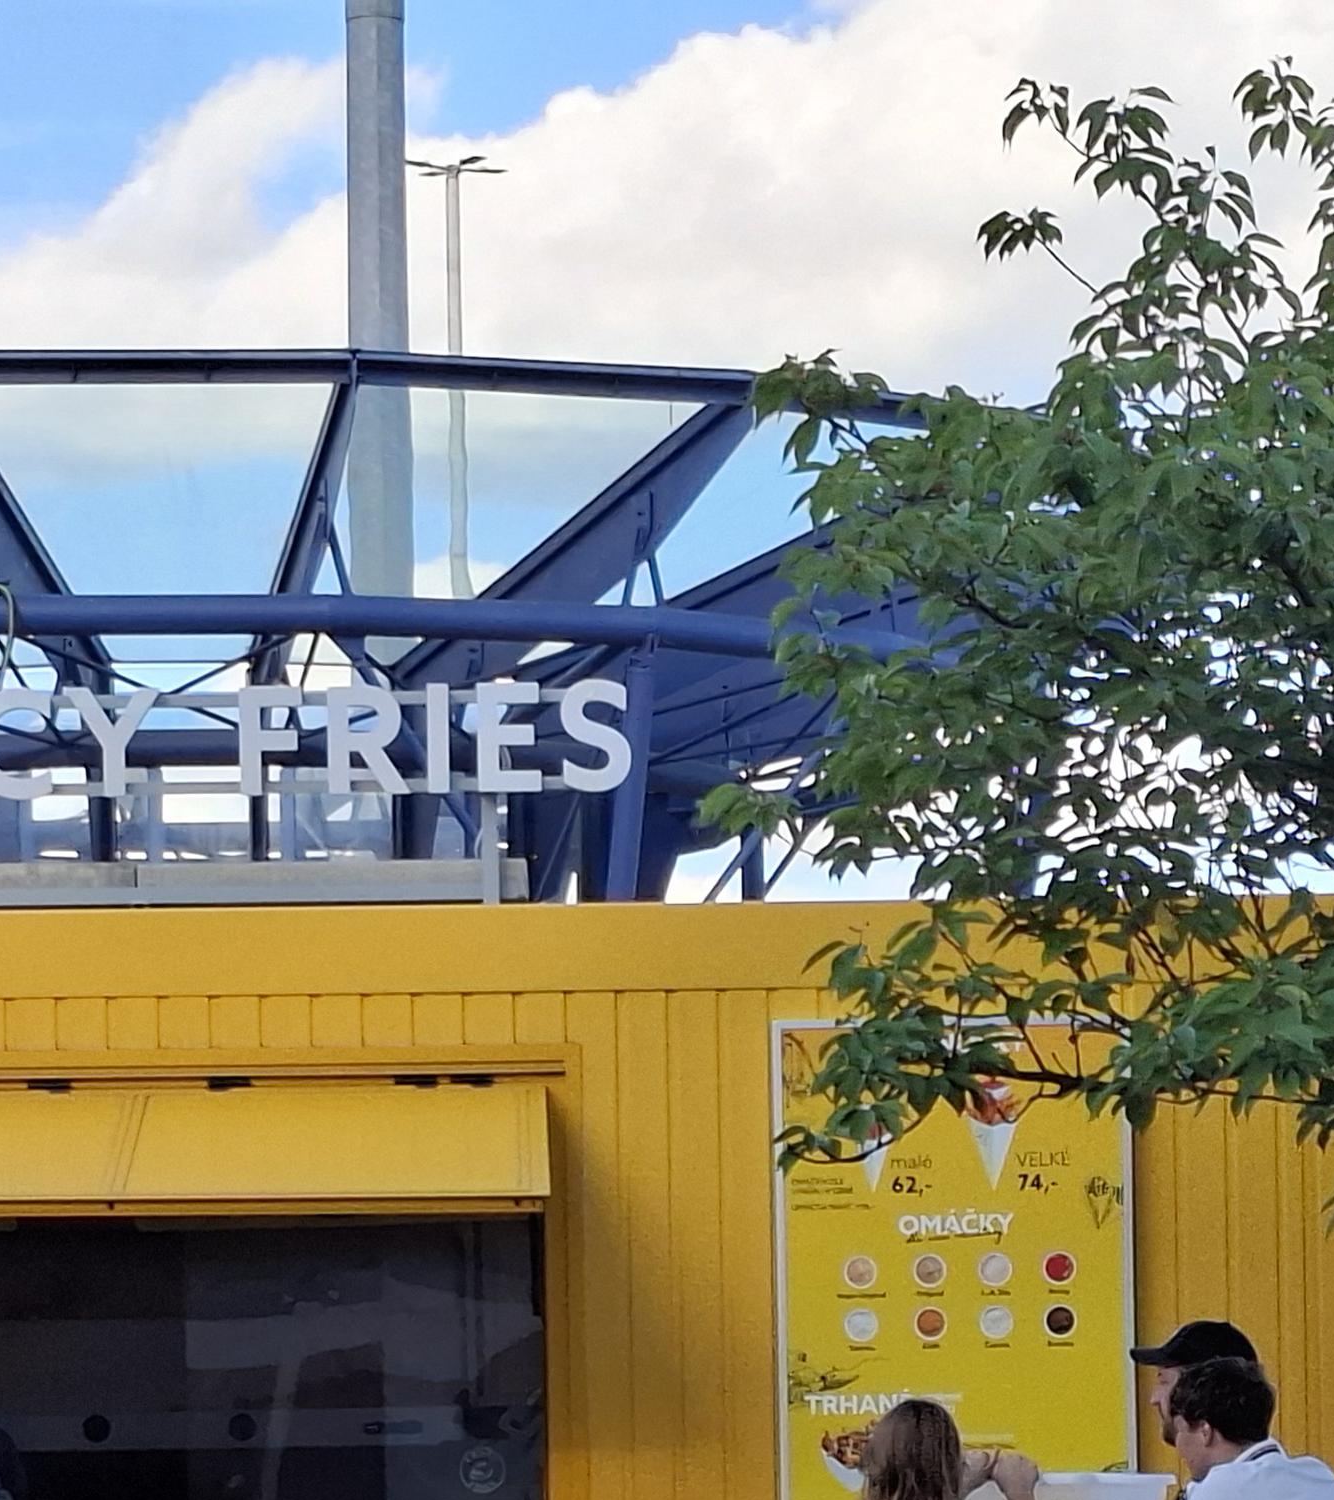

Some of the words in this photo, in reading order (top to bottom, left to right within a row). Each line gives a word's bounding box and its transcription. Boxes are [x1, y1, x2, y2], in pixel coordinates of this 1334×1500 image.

[238, 679, 633, 797] FRIES
[891, 1175, 933, 1197] 62,-
[1017, 1173, 1059, 1195] 74,-
[897, 1207, 1014, 1236] OMÁČKY
